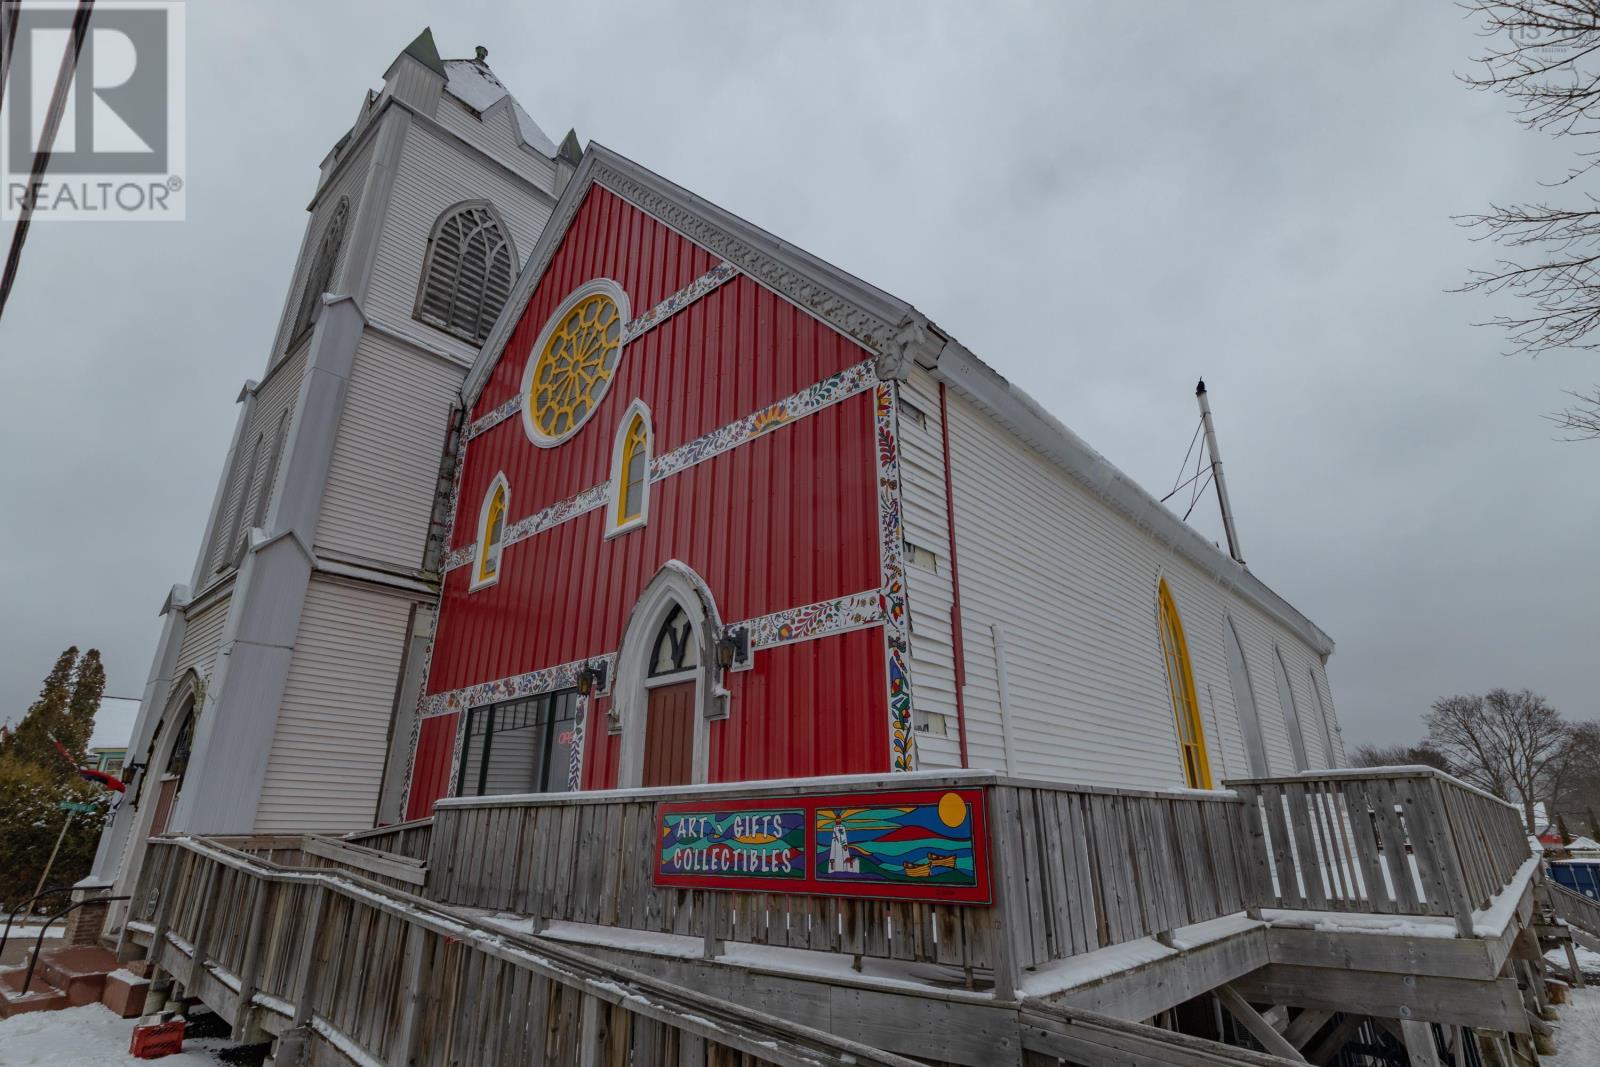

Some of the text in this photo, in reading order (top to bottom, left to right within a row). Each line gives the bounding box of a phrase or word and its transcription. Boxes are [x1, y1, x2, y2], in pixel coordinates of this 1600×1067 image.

[677, 815, 783, 839] ART GIFTS
[674, 847, 792, 873] COLLECTIBLES
